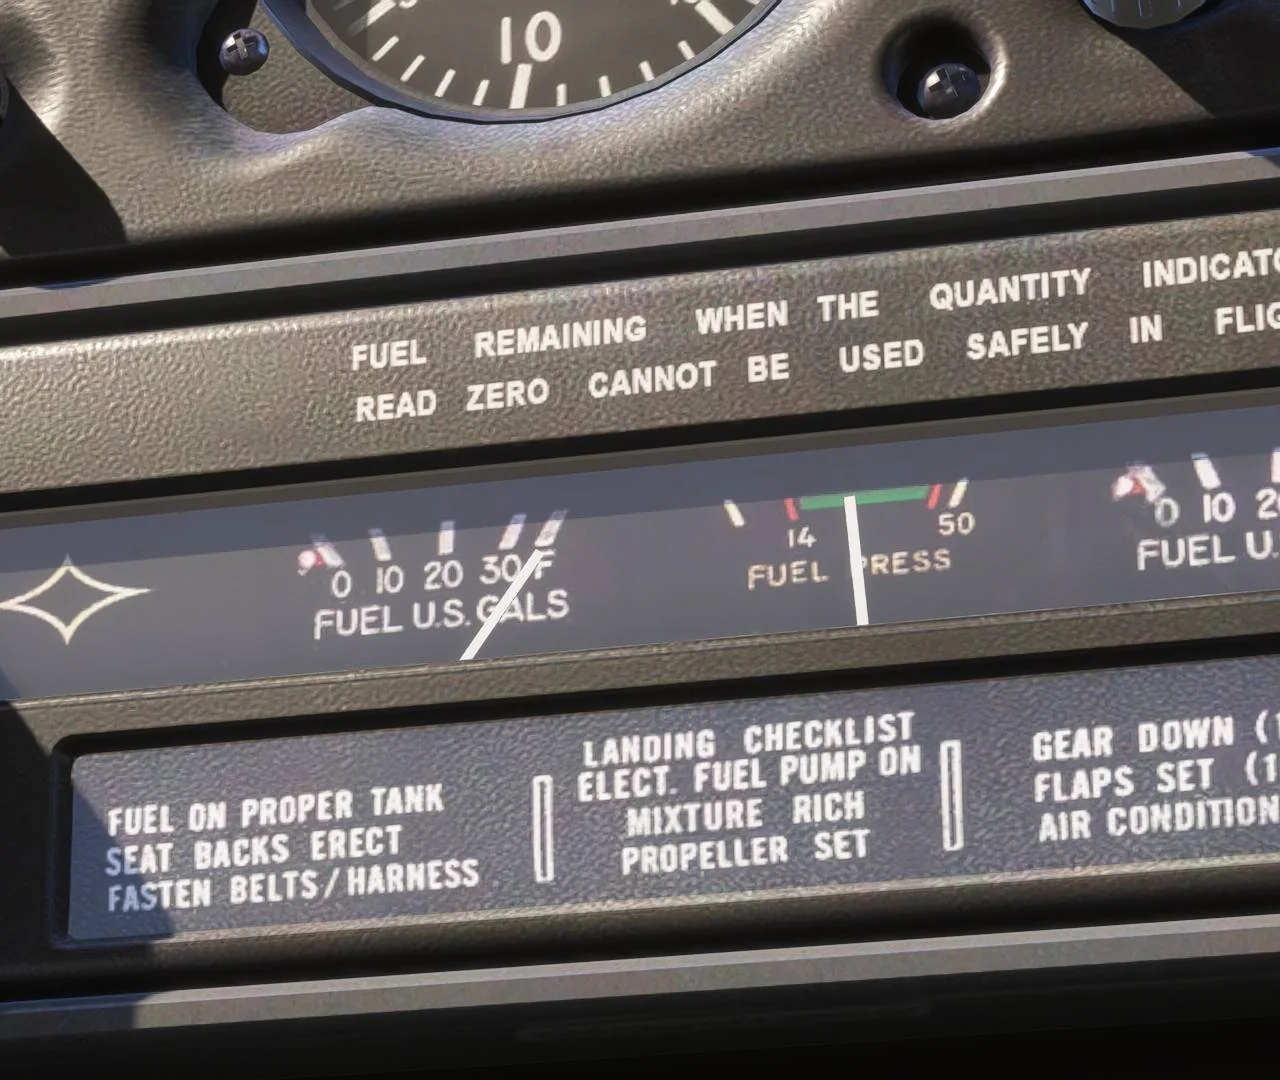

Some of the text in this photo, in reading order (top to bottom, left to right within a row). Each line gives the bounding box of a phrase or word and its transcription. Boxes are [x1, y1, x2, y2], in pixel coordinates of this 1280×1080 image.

[501, 10, 562, 64] 10
[351, 339, 427, 371] FUEL
[474, 315, 648, 359] REMAINING
[695, 300, 789, 335] WHEN
[817, 290, 880, 323] THE
[929, 268, 1092, 312] QUANTITY
[355, 389, 438, 423] READ
[465, 378, 550, 412] ZERO
[587, 360, 718, 399] CANNOT
[747, 353, 790, 384] BE
[838, 339, 925, 374] USED
[966, 322, 1089, 361] SAFELY
[1129, 314, 1163, 345] IN
[787, 512, 976, 549] 14 50
[1202, 492, 1236, 524] 10
[331, 554, 523, 599] 0 10 20 30
[747, 559, 830, 591] FUEL
[1137, 535, 1236, 571] FUEL
[313, 605, 403, 640] FUEL
[582, 711, 916, 769] LANDING CHECKLIST
[1032, 725, 1114, 764] GEAR
[1138, 714, 1235, 754] DOWN
[577, 744, 921, 802] ELECT. FUEL PUMP ON
[1032, 765, 1135, 804] FLAPS
[1156, 757, 1215, 794] SET
[107, 782, 445, 837] FUEL ON PROPER TANK
[626, 790, 865, 838] MIXTURE RICH
[1037, 807, 1092, 843] AIR
[105, 824, 403, 876] SEAT BACKS ERECT
[622, 828, 871, 877] PROPELLER SET
[108, 878, 211, 913] FASTEN
